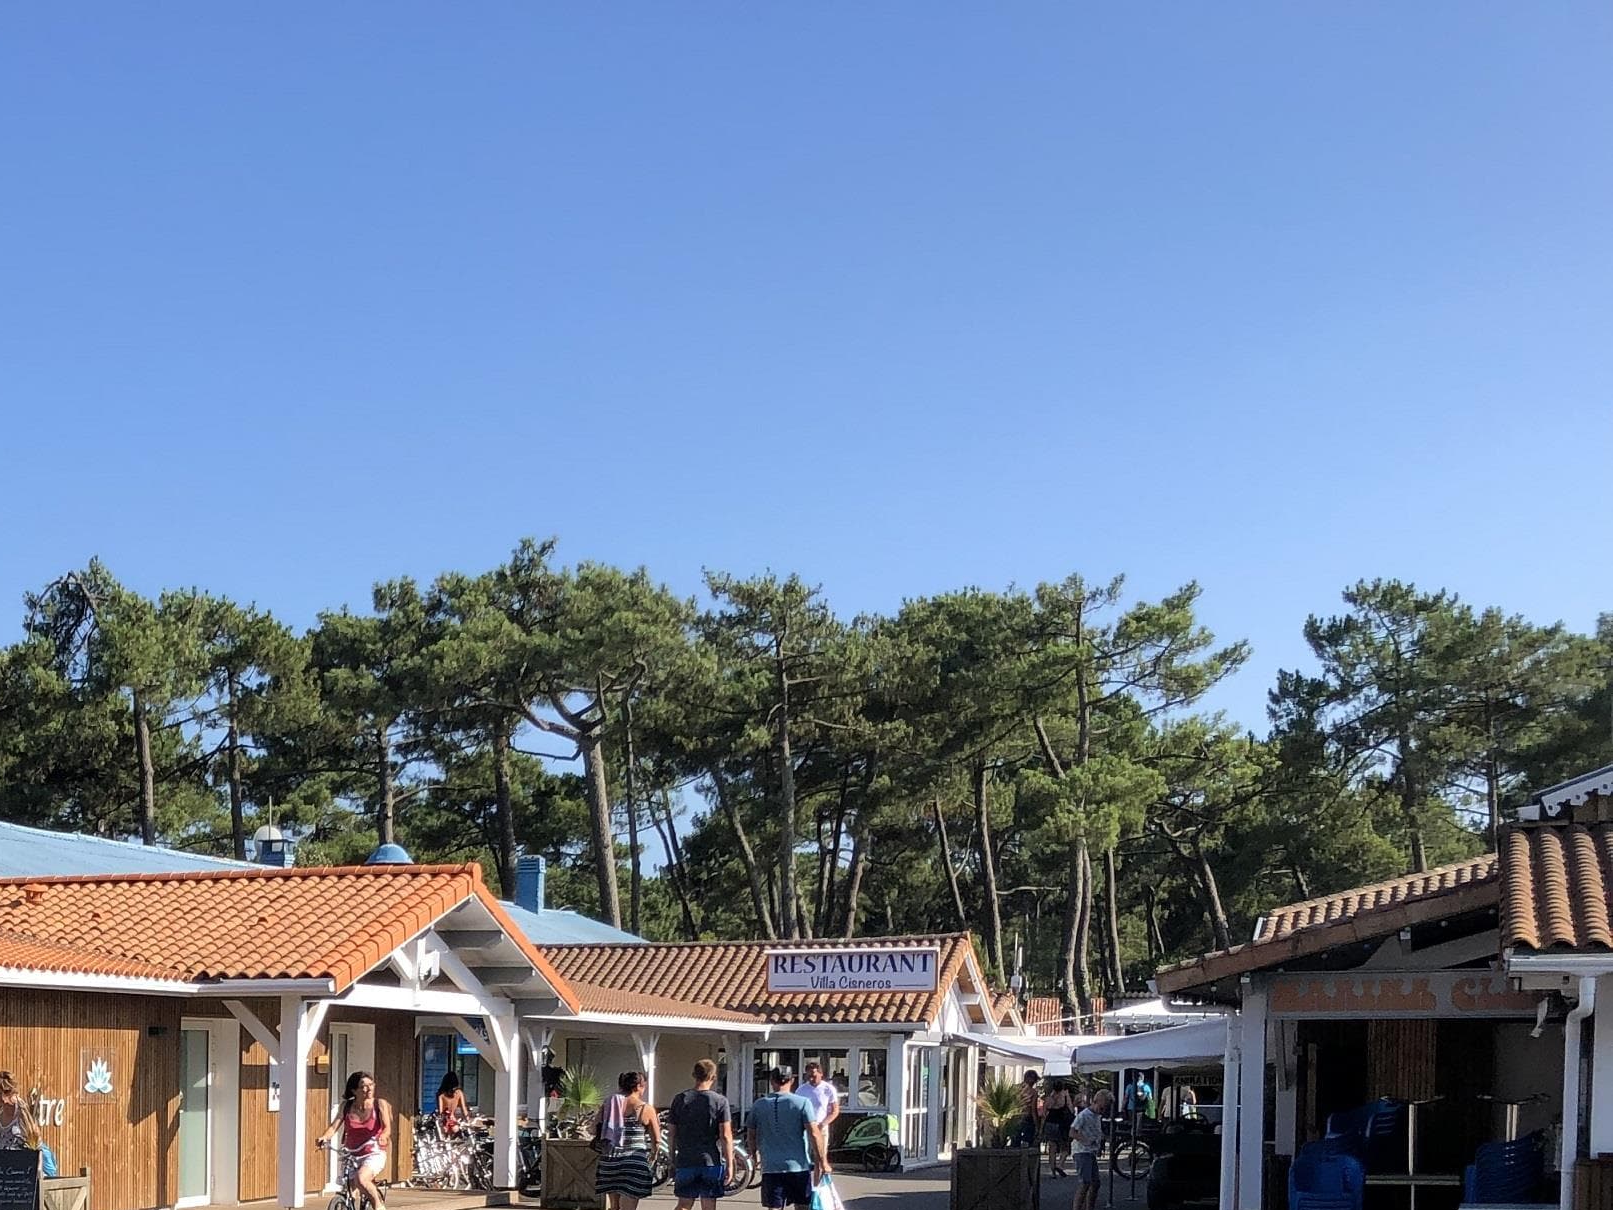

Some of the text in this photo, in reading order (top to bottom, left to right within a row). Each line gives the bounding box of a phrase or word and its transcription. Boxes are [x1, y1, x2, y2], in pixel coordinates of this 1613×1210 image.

[773, 952, 934, 974] RESTAURANT
[811, 975, 892, 989] Villa Cisneros
